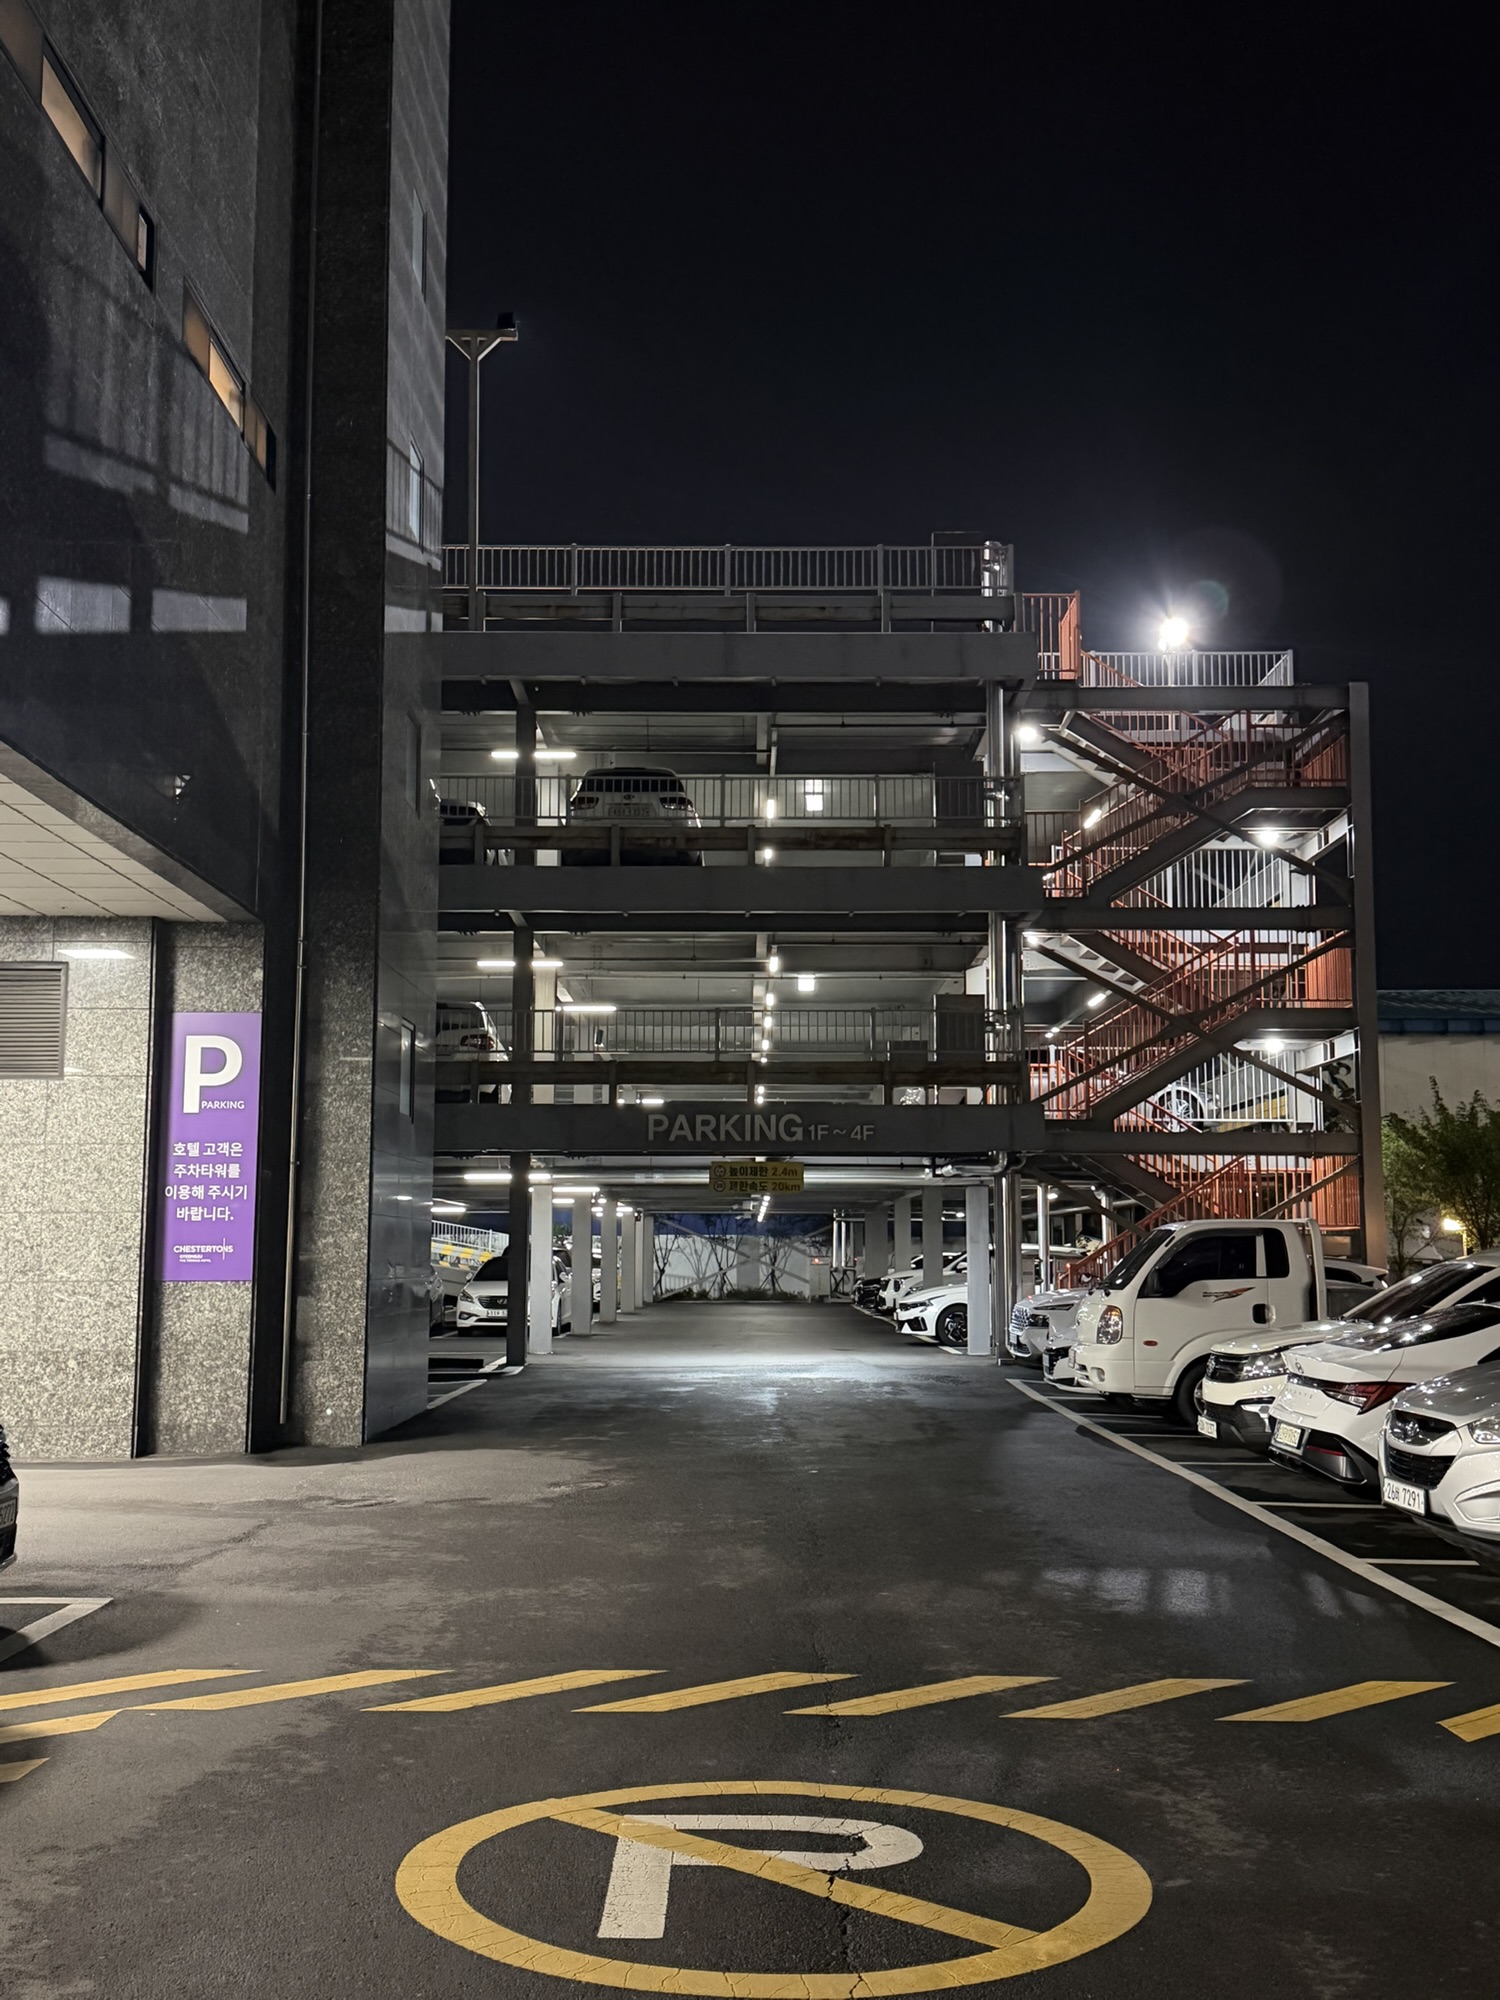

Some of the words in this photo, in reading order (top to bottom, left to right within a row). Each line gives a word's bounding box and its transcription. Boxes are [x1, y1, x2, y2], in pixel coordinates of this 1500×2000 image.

[183, 1035, 243, 1114] P
[201, 1100, 245, 1110] PARKING
[648, 1113, 804, 1142] PARKING
[173, 1142, 200, 1157] 호텔
[203, 1142, 243, 1157] 고객은
[173, 1163, 241, 1179] 주차타워를
[729, 1166, 768, 1177] 높이제한
[771, 1167, 798, 1177] 2.4m
[165, 1185, 204, 1200] 이용해
[207, 1184, 248, 1201] 주시기
[728, 1181, 768, 1192] 제한속도
[771, 1181, 801, 1192] 20km
[176, 1206, 234, 1222] 바랍니다.
[173, 1244, 234, 1253] CHESTERTONS
[1402, 1487, 1420, 1510] 7291
[597, 1814, 924, 1938] P
